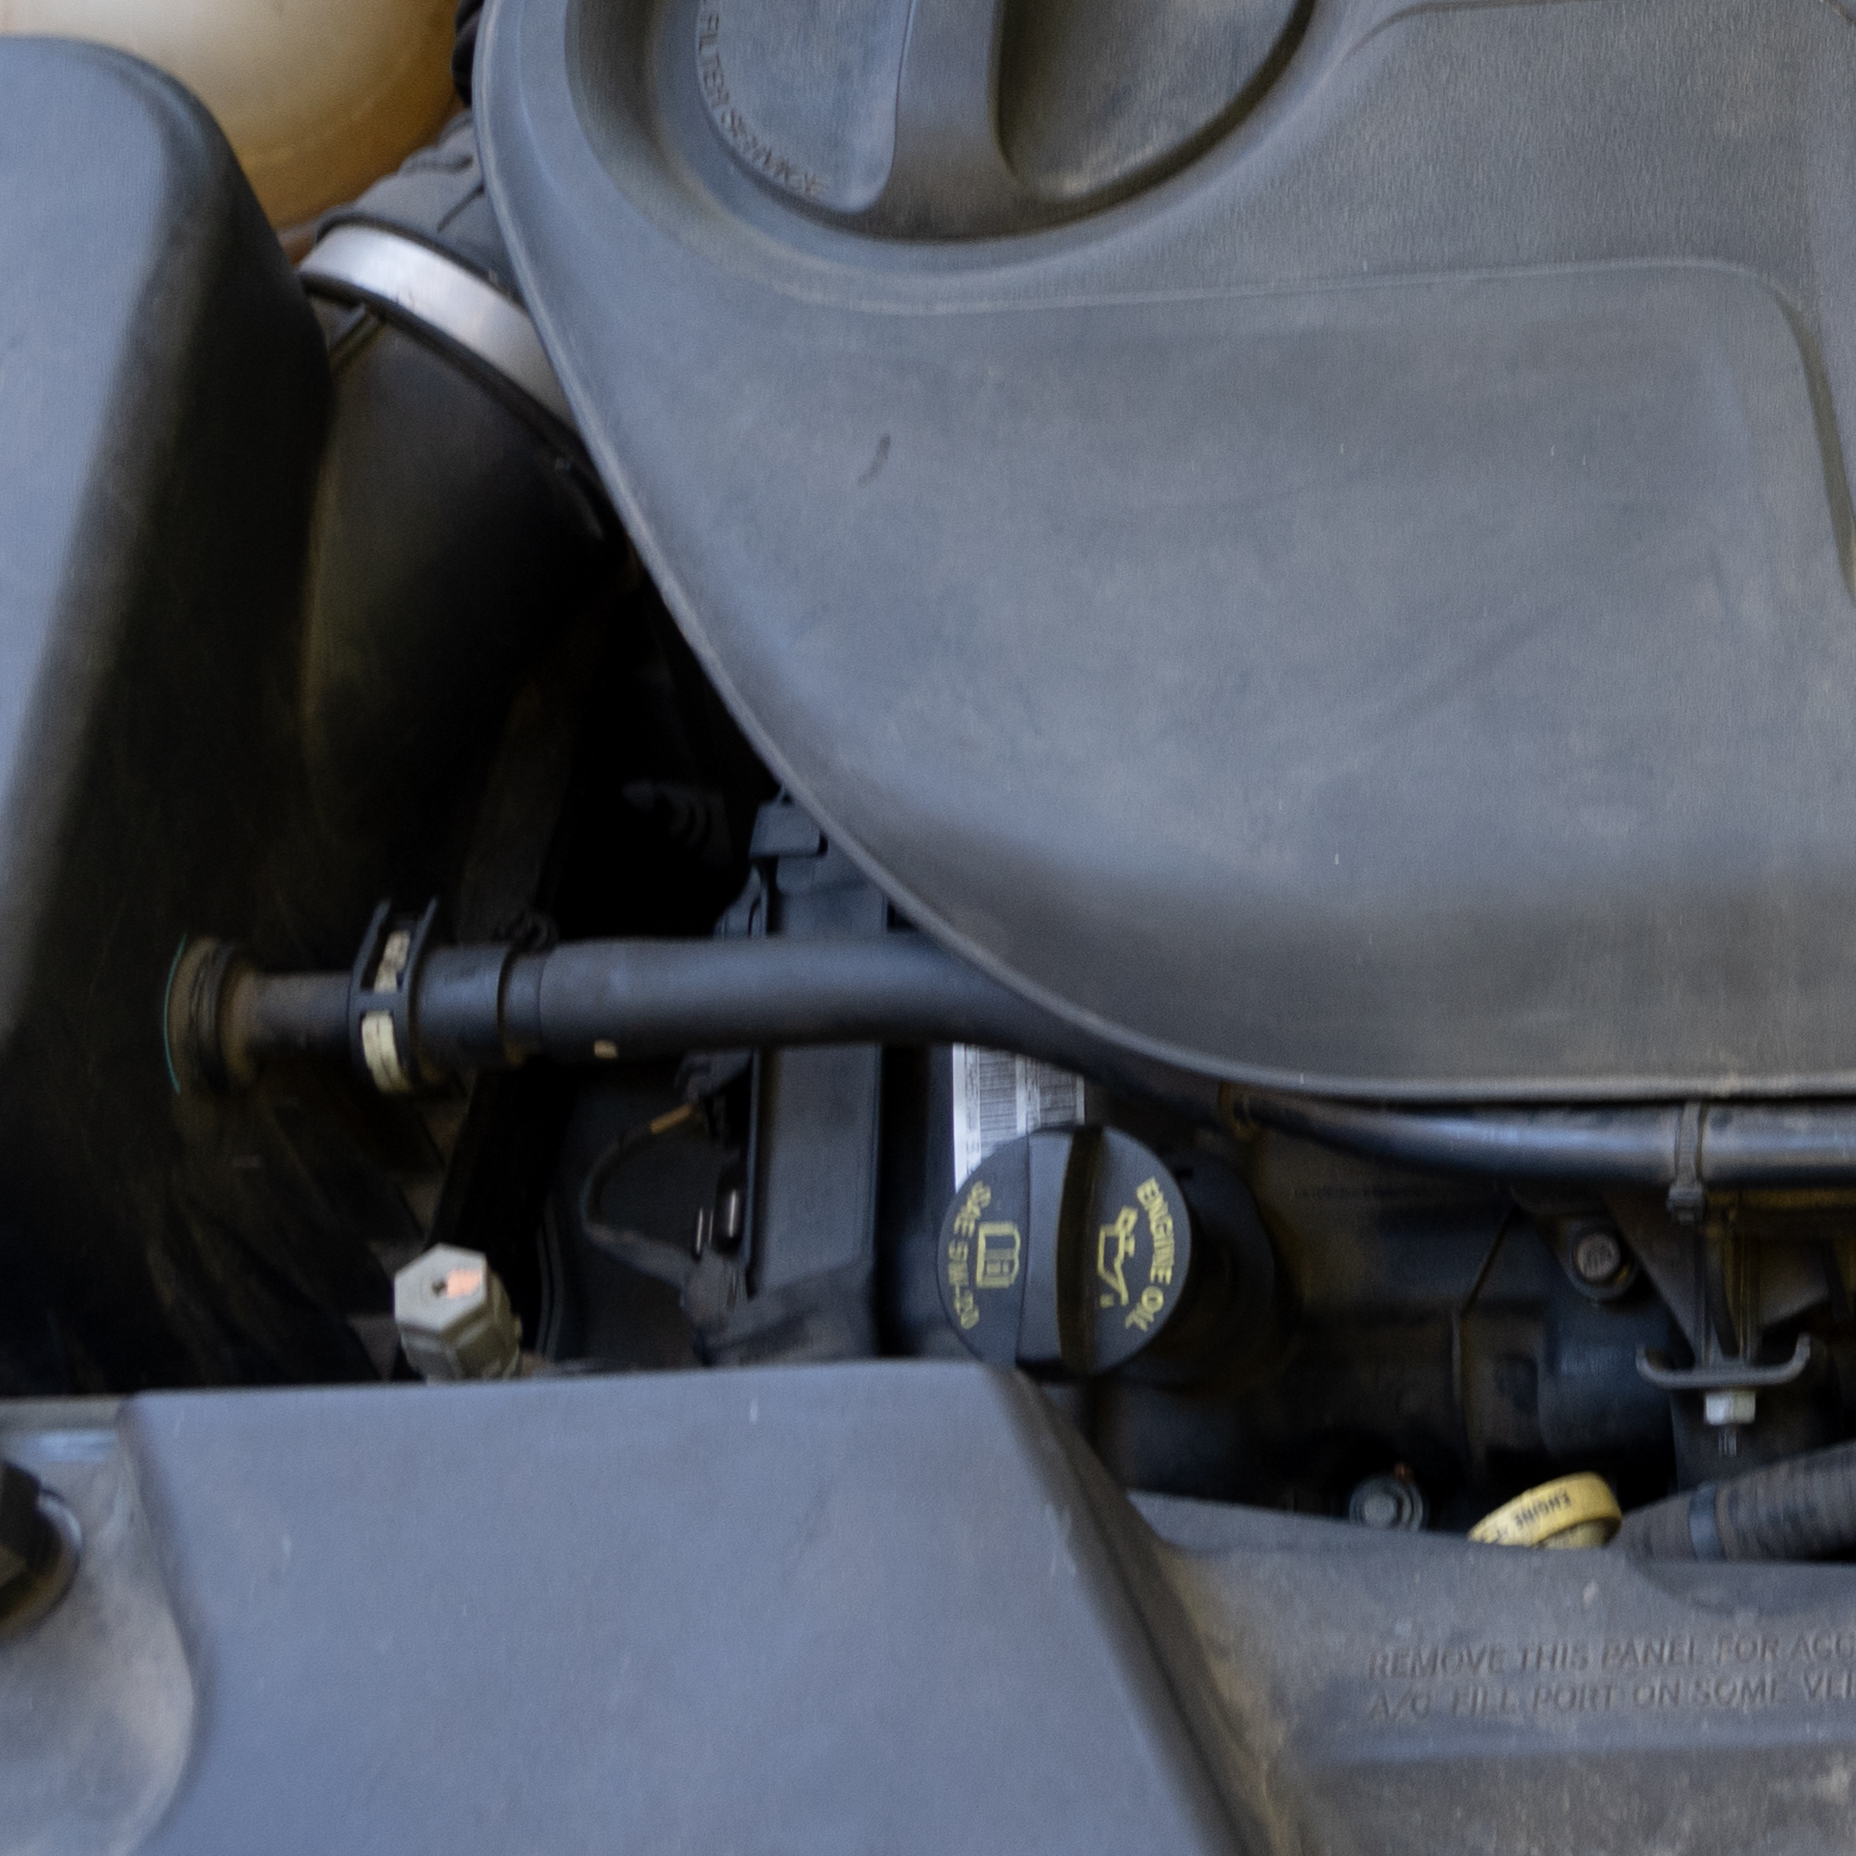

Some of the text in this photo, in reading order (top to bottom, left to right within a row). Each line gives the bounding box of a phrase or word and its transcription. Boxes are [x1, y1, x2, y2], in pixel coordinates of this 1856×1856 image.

[697, 15, 731, 110] FILTER
[953, 1180, 991, 1238] SAE
[1123, 1175, 1175, 1333] ENGINE OIL
[1512, 1490, 1572, 1531] ENGINE
[1369, 1641, 1506, 1680] REMOVE
[1518, 1637, 1590, 1673] THIS
[1602, 1633, 1706, 1670] PANEL
[1716, 1631, 1780, 1664] FOR
[1368, 1686, 1432, 1722] A/C
[1451, 1684, 1518, 1717] FILL
[1531, 1683, 1617, 1715] PORT
[1631, 1679, 1682, 1709] ON
[1690, 1674, 1788, 1708] SOME
